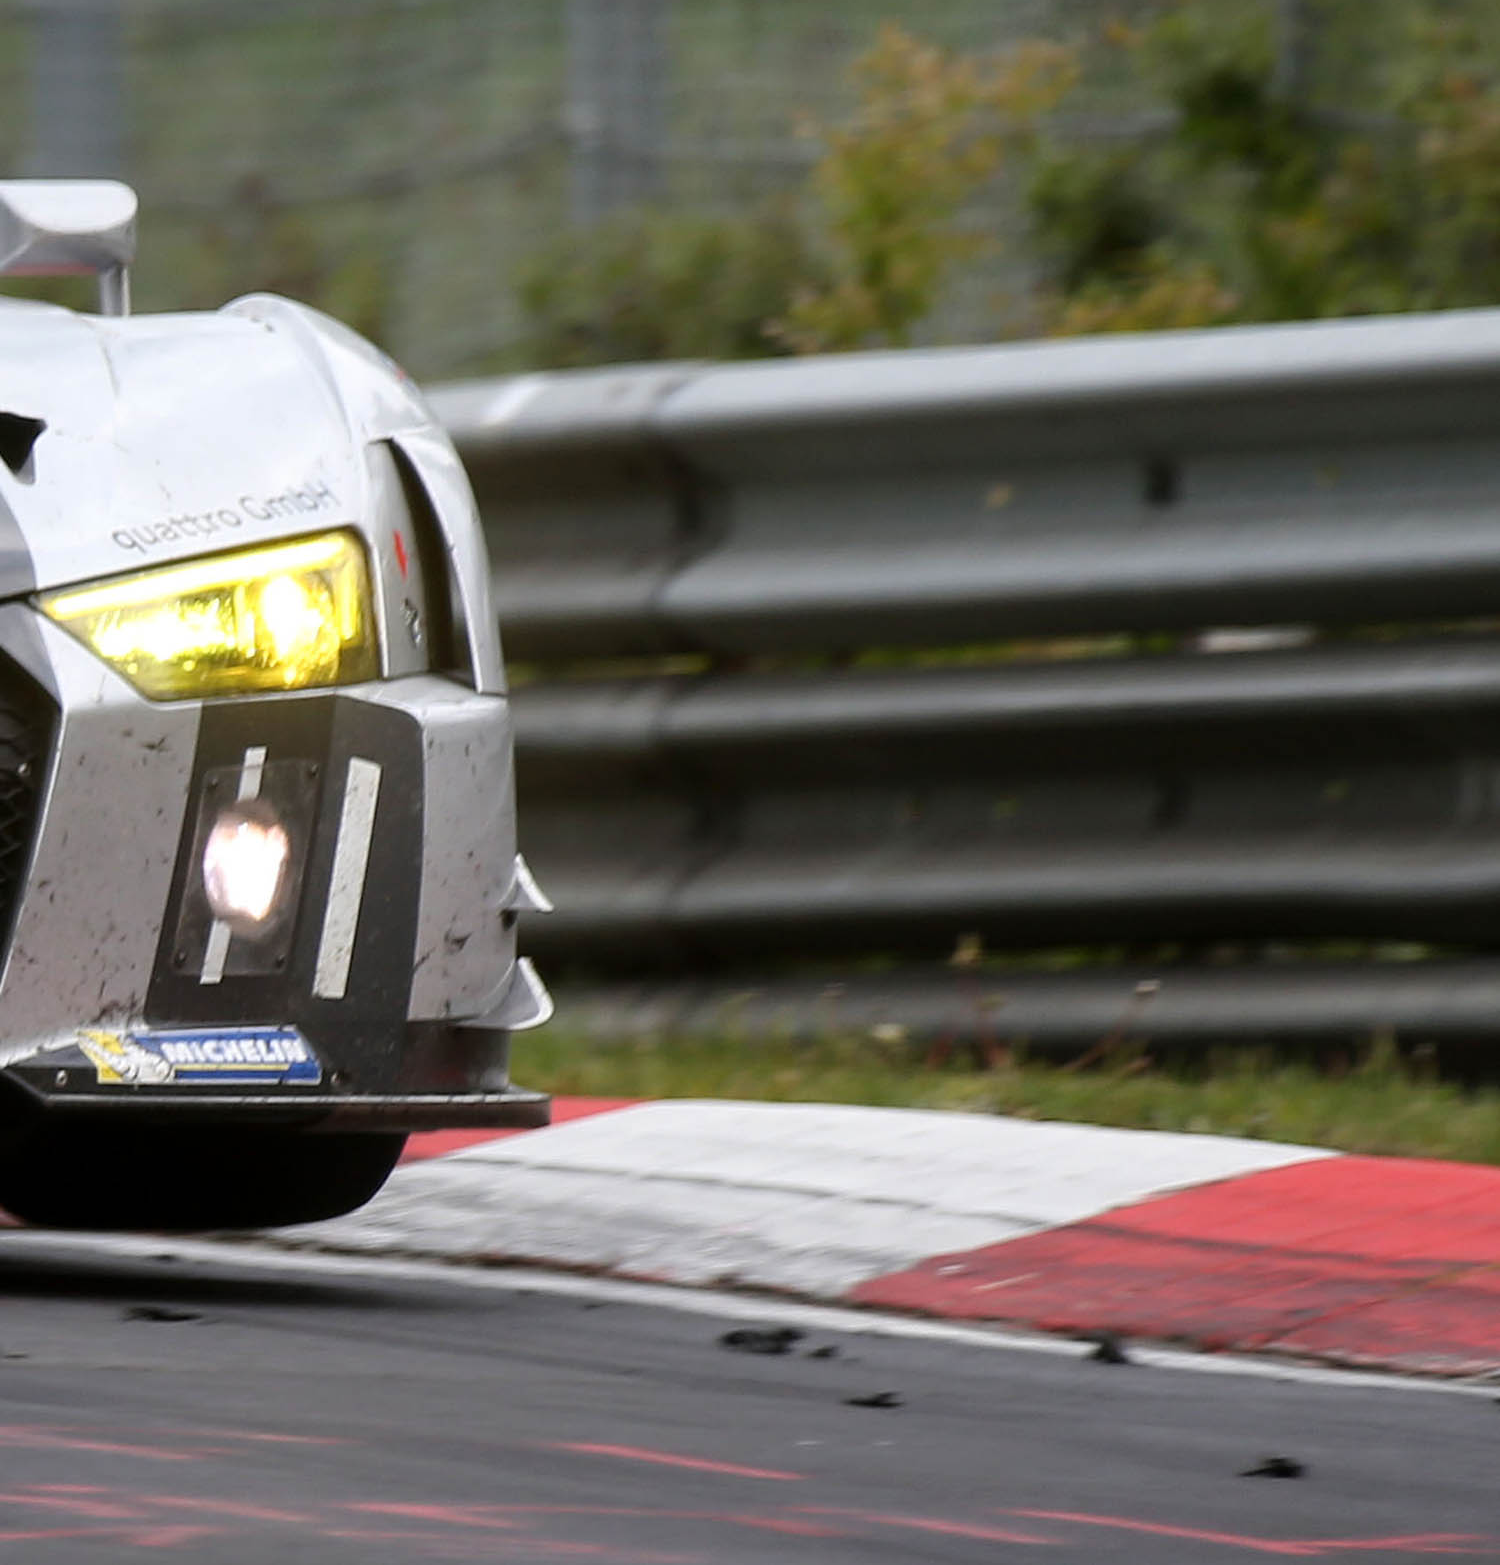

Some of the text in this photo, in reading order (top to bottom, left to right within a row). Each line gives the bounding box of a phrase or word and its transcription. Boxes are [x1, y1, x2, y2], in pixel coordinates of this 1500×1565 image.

[111, 481, 343, 554] quattro GmbH
[160, 1038, 308, 1064] MICHELIN
